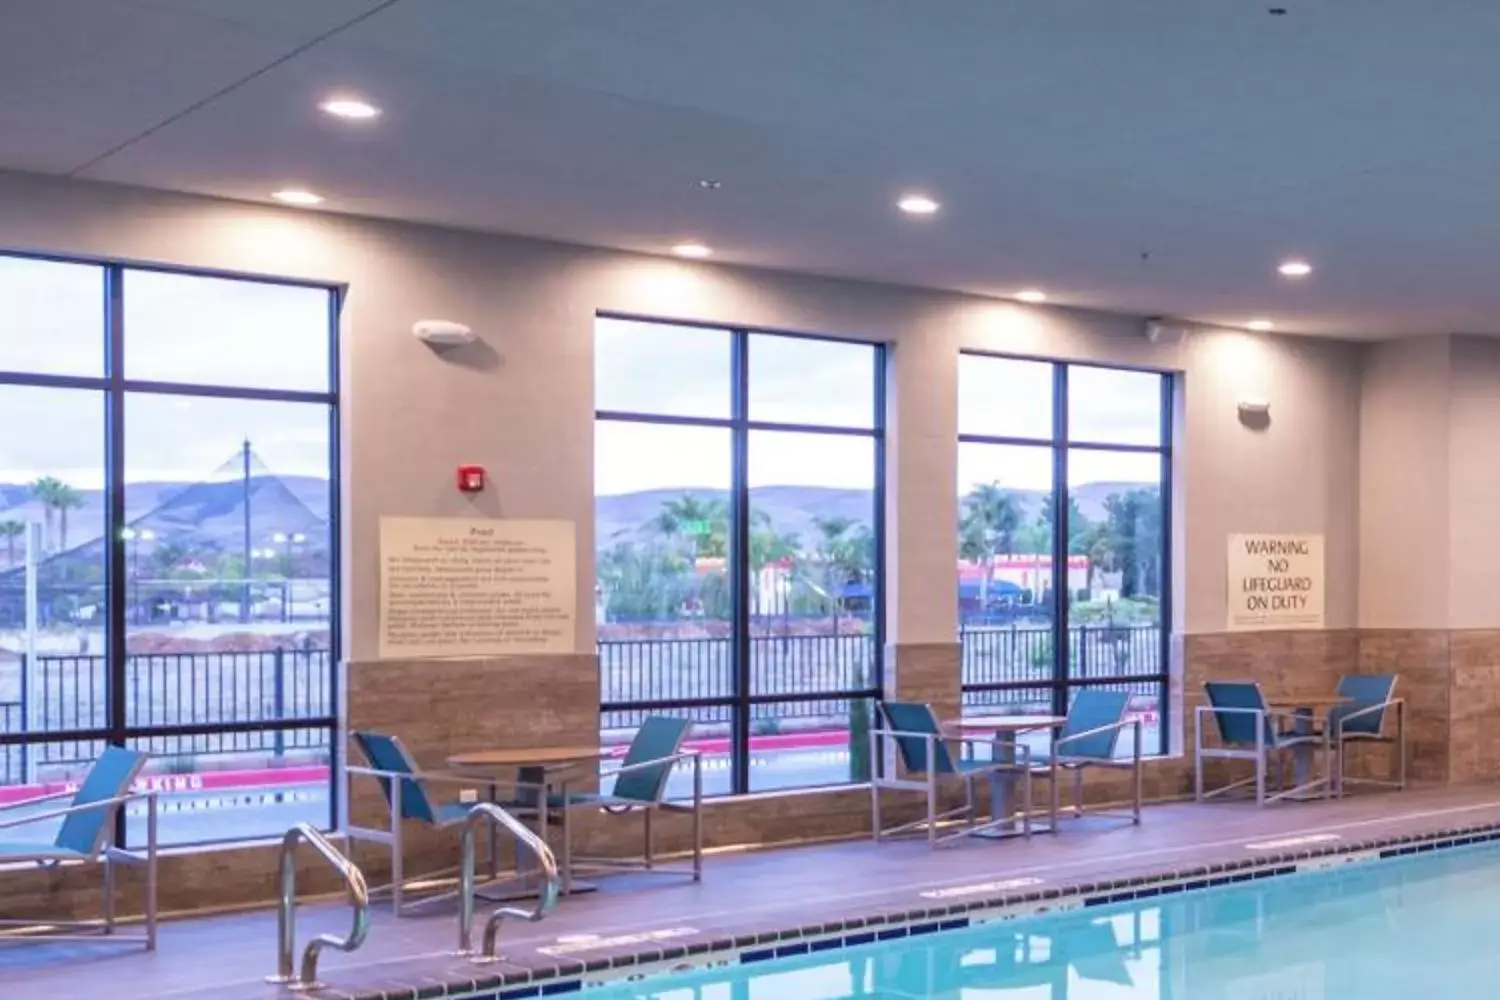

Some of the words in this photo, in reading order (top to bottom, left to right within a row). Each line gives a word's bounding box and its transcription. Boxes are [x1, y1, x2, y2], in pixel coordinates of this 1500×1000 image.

[1245, 540, 1308, 555] WARNING
[1267, 558, 1289, 573] NO
[1243, 576, 1312, 592] LIFEGUARD
[1247, 595, 1268, 611] ON
[1271, 595, 1307, 611] DUTY
